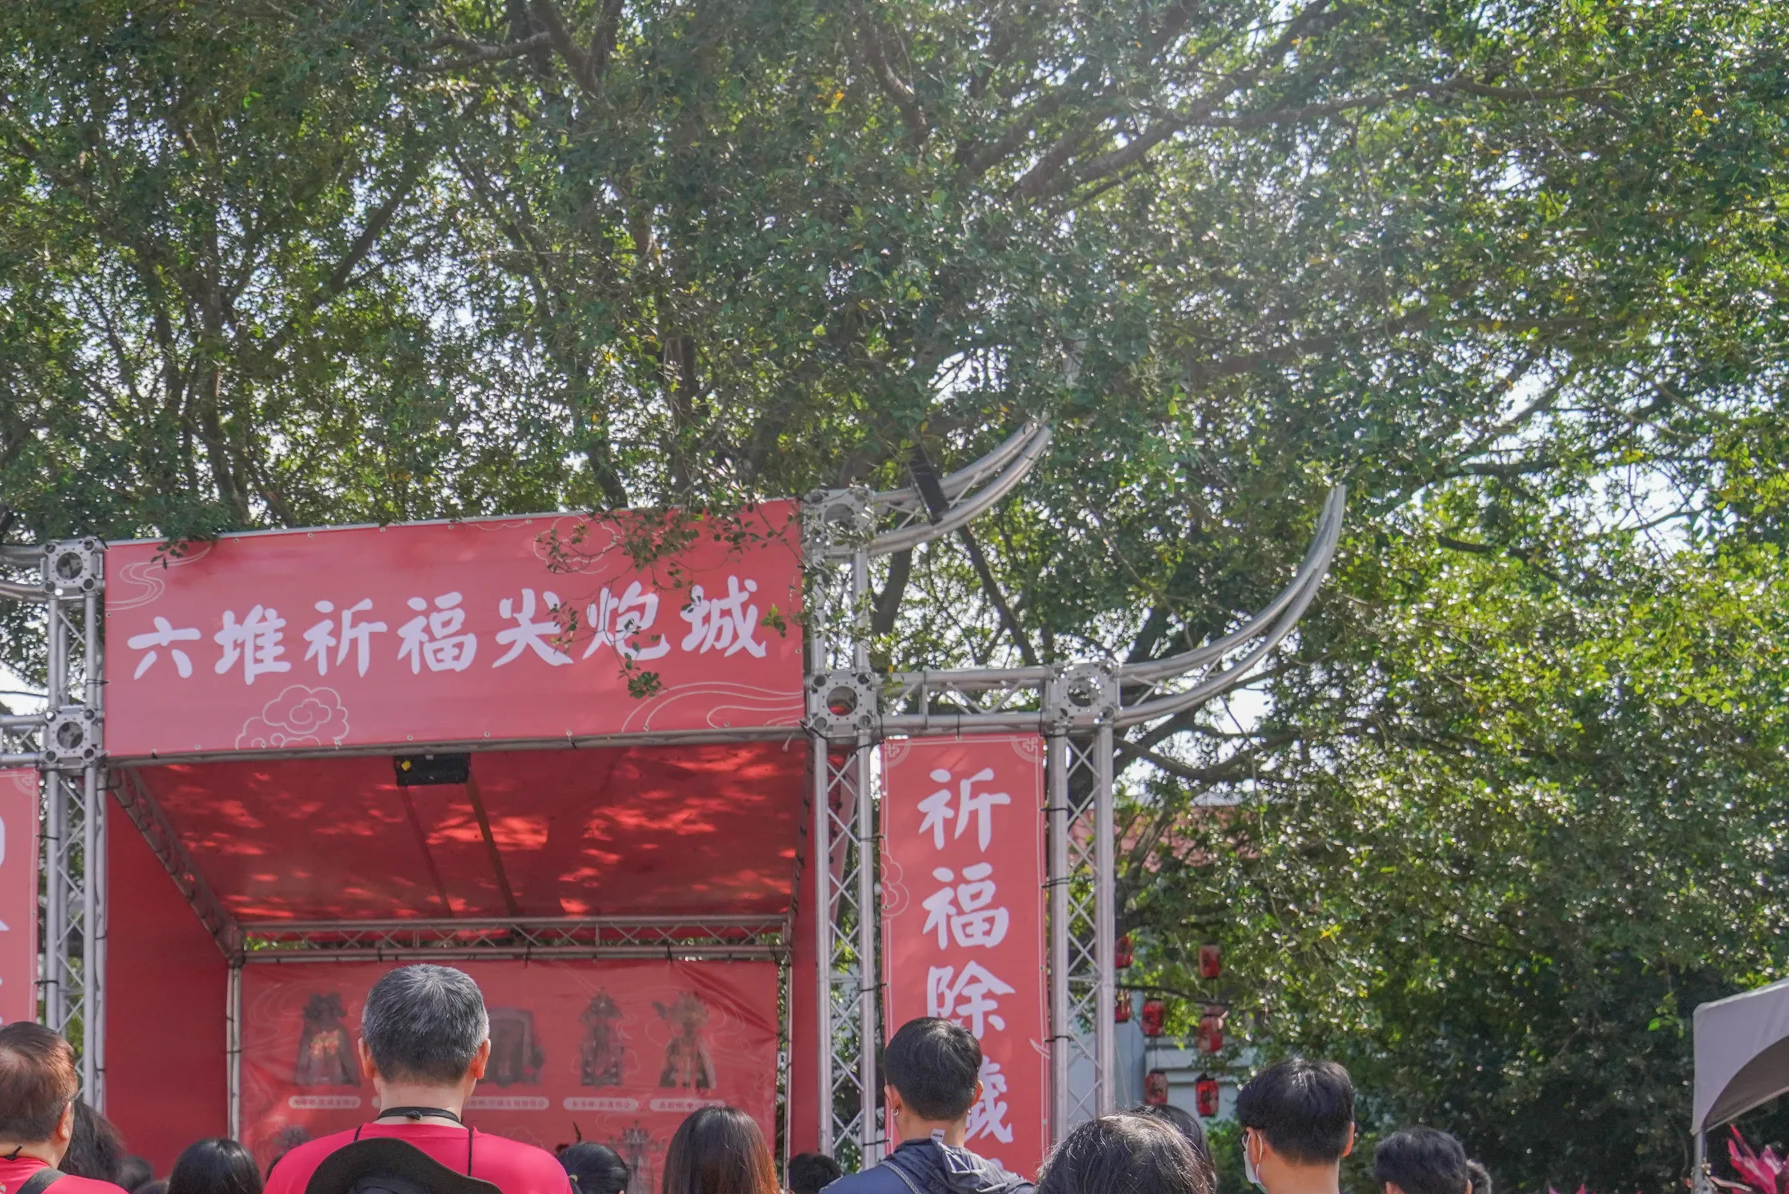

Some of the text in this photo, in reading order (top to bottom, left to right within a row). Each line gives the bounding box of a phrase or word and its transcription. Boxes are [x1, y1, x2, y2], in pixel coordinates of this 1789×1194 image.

[126, 575, 768, 686] 六堆祈福尖炮城
